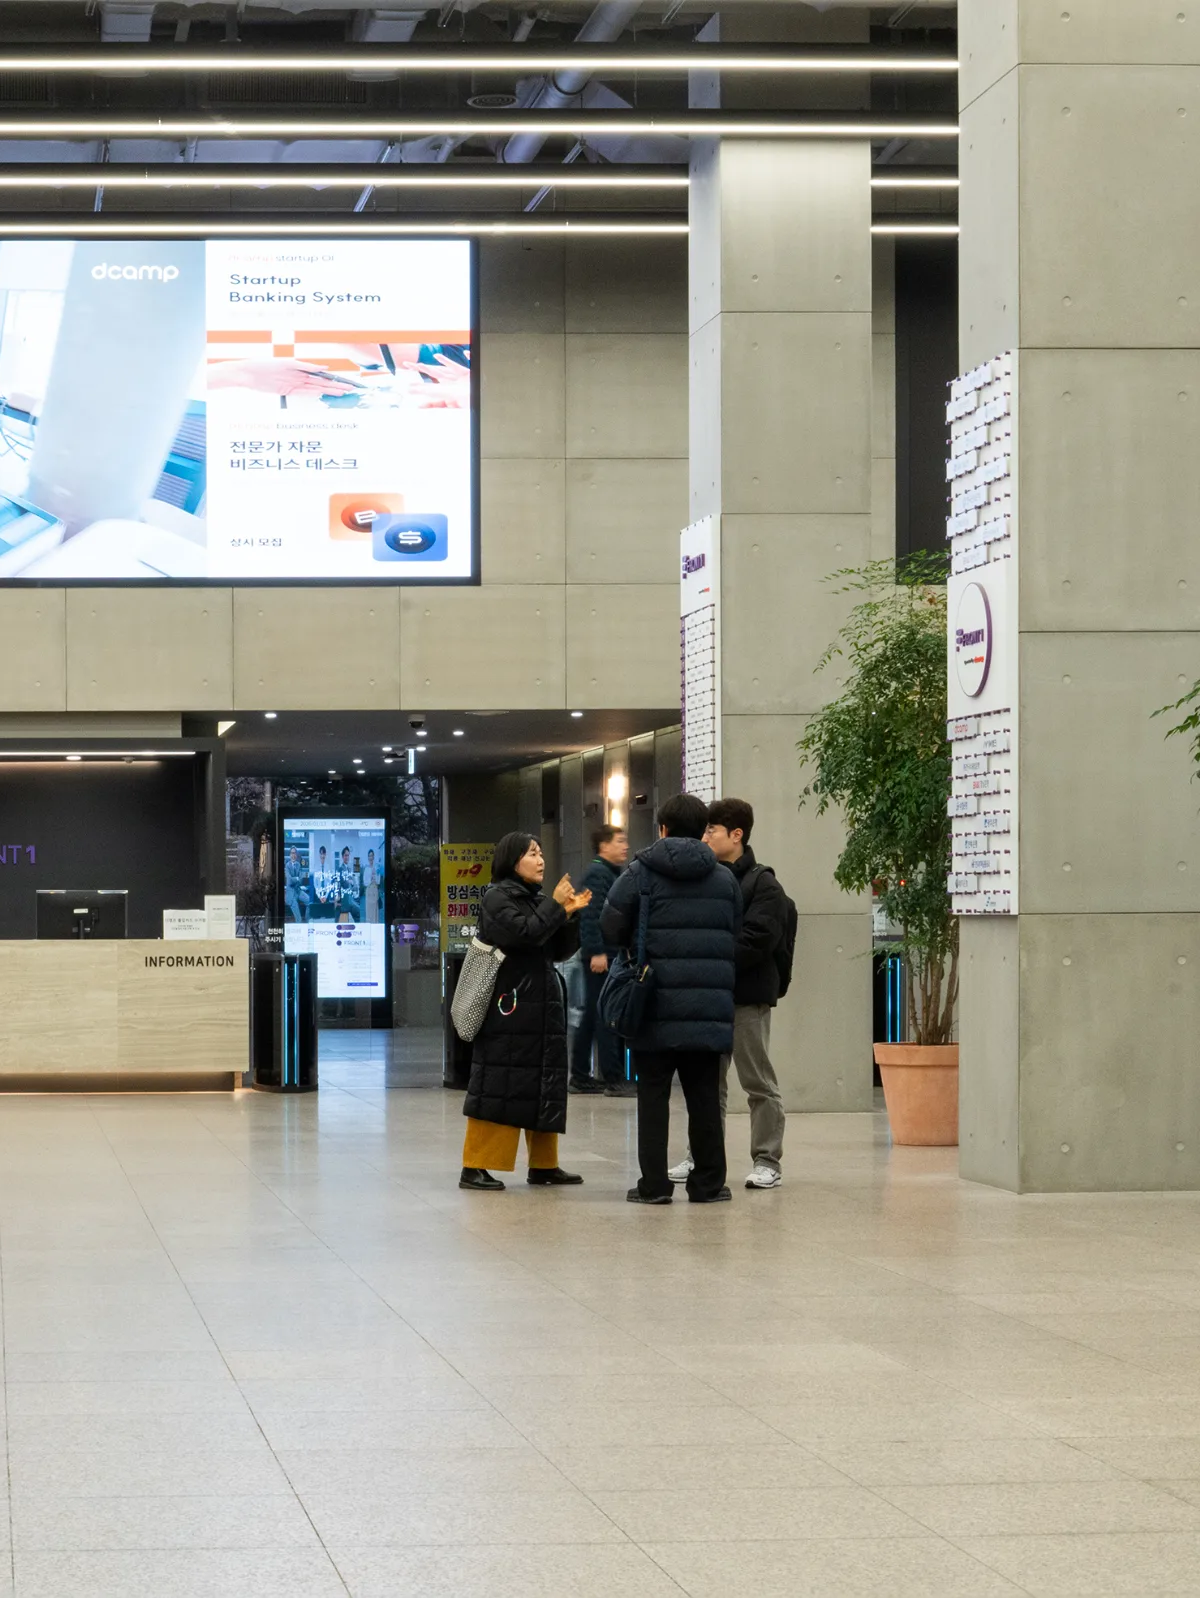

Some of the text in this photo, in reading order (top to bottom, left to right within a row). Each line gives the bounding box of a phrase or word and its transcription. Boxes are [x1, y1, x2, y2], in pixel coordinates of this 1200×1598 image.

[275, 255, 318, 263] startup
[91, 262, 179, 283] dcamp
[230, 274, 301, 287] Startup
[229, 291, 381, 305] Banking System
[230, 440, 323, 453] 전문가 자문
[230, 458, 359, 471] 비즈니스 데스크
[457, 864, 483, 878] 119
[144, 955, 234, 968] INFORMATION
